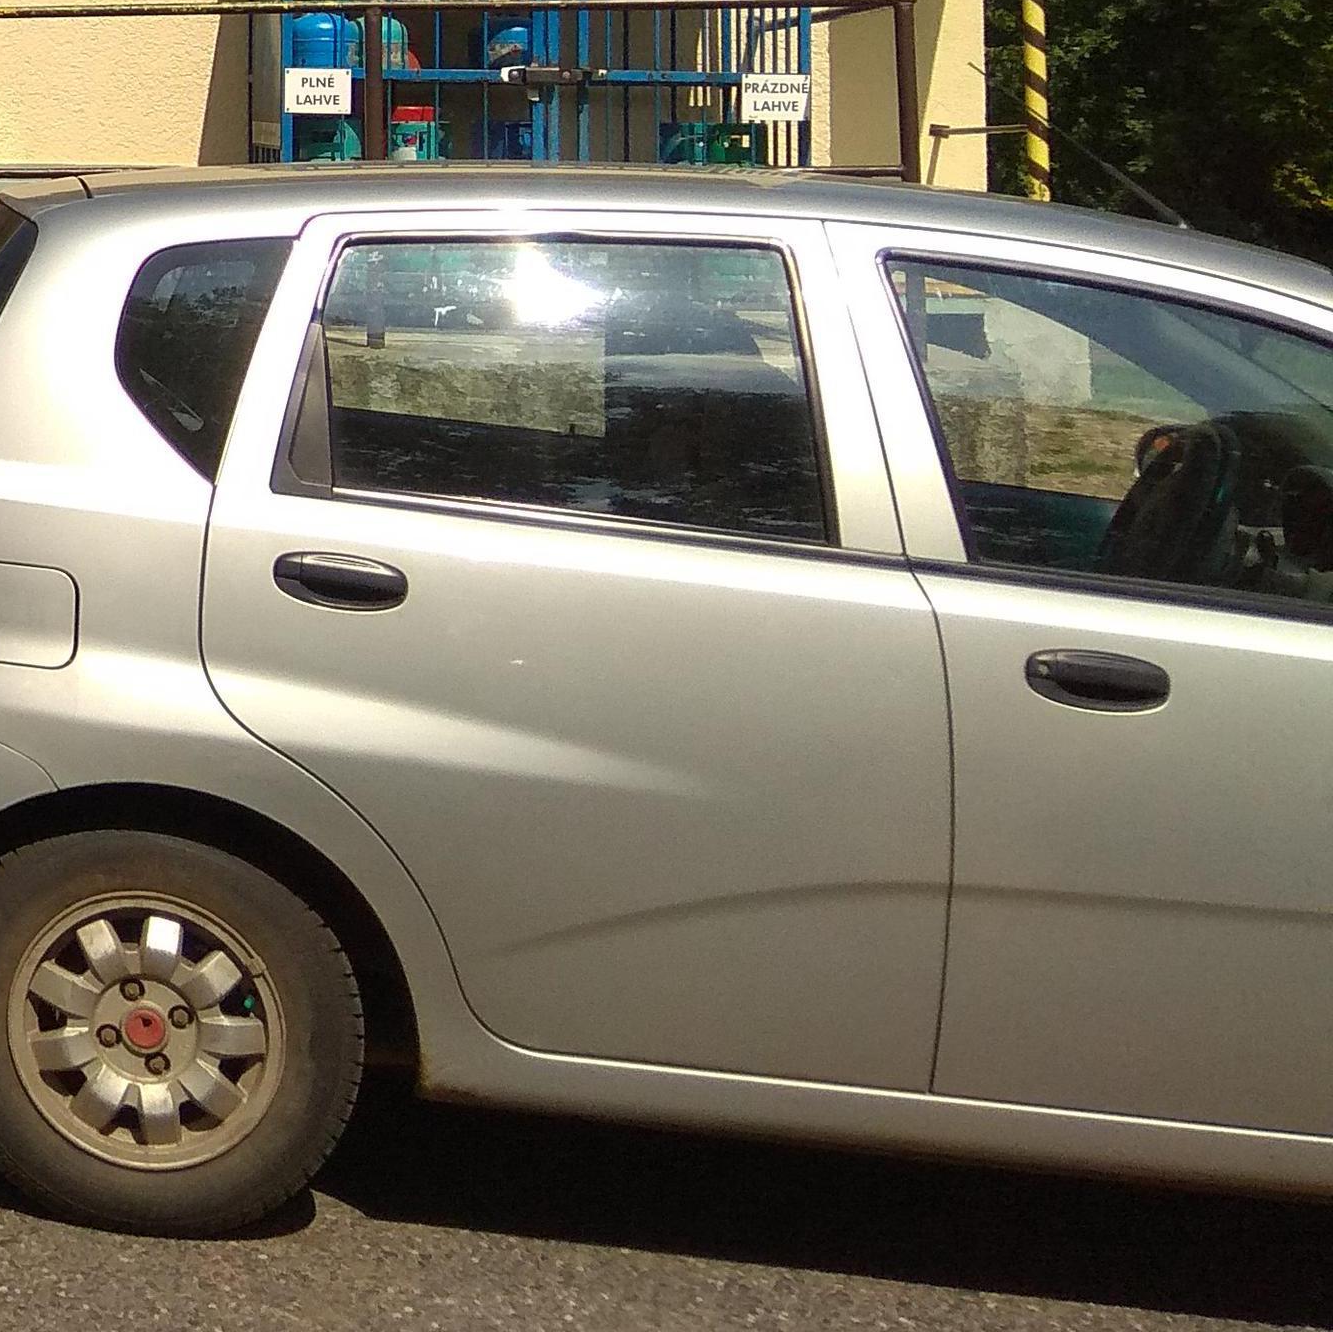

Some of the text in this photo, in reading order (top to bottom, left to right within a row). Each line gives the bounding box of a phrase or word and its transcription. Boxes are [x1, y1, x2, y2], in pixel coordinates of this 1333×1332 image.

[301, 73, 335, 88] PLNÉ
[744, 76, 809, 94] PRÁZDNÉ
[296, 94, 340, 105] LAHVE
[753, 101, 799, 111] LAHVE
